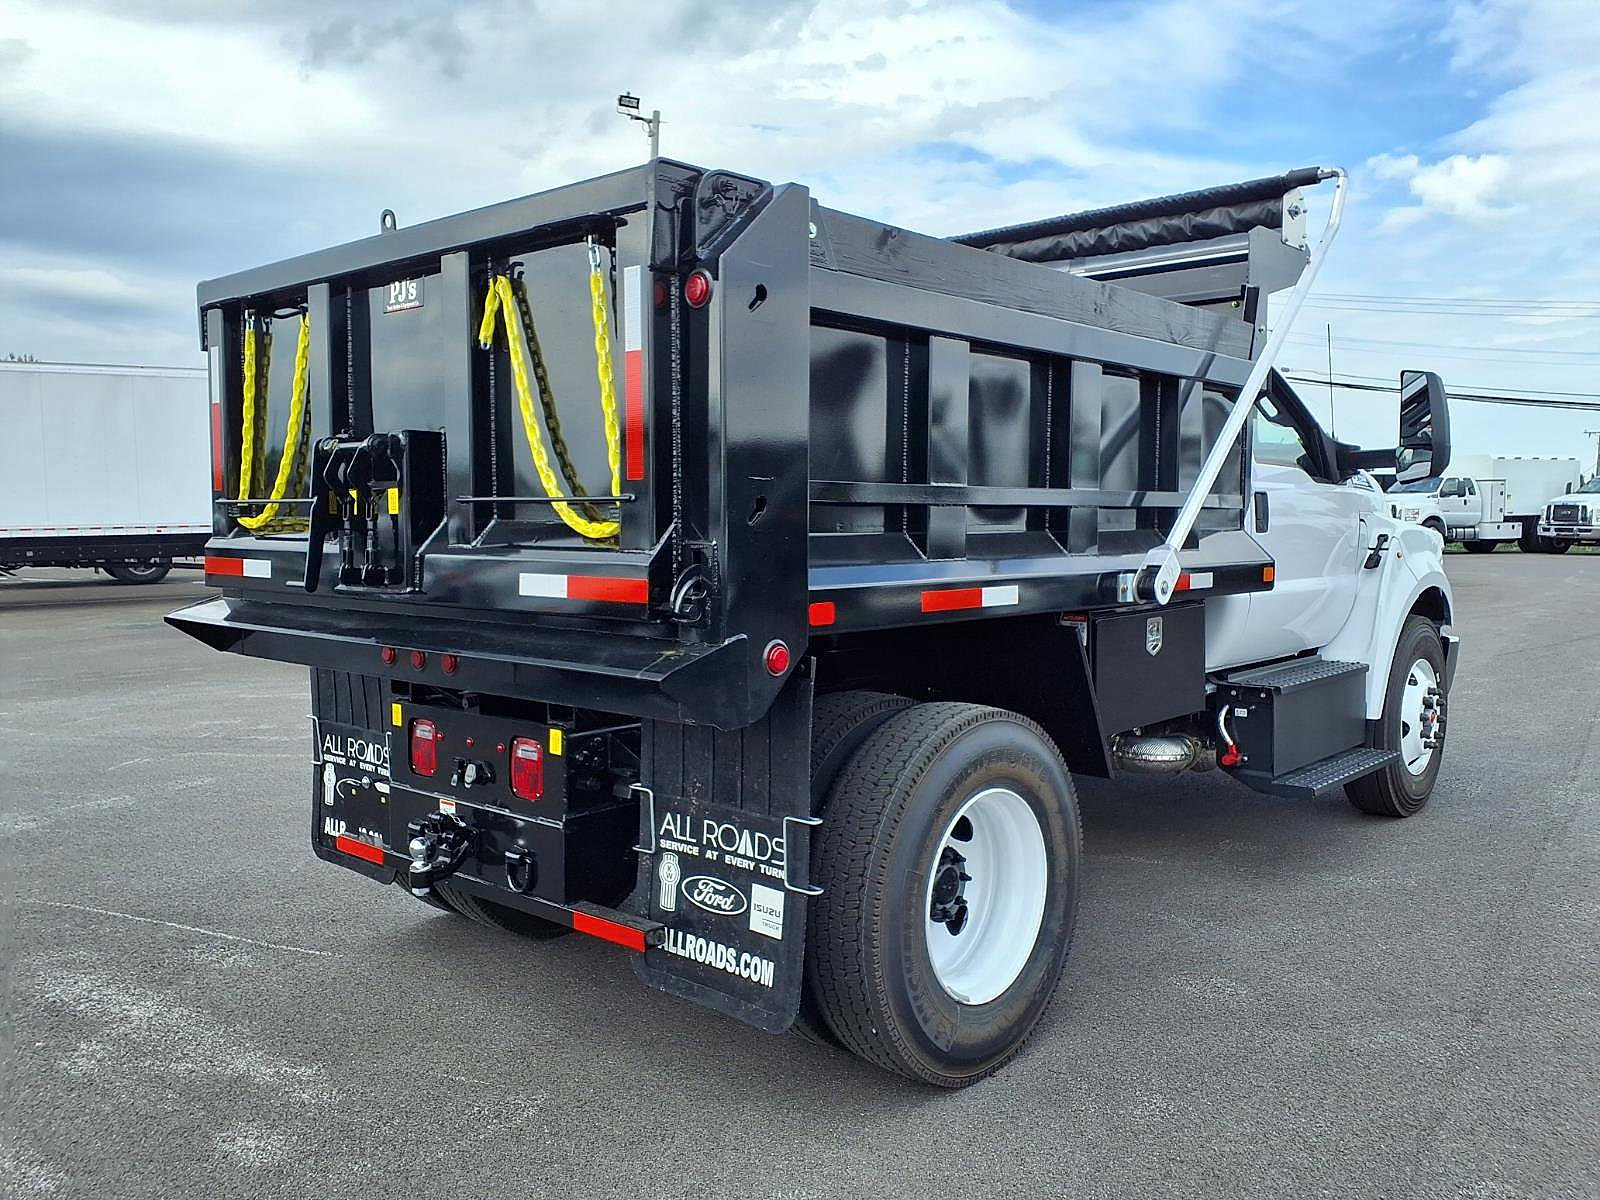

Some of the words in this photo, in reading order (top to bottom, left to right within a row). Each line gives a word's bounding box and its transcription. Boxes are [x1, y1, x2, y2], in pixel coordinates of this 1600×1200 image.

[389, 280, 417, 304] PJ's
[323, 733, 345, 756] ALL
[347, 737, 390, 768] ROADS
[349, 759, 357, 768] AT
[659, 811, 697, 843] ALL
[702, 819, 785, 866] ROADS
[659, 838, 700, 856] SERVICE
[705, 849, 719, 861] AT
[724, 854, 756, 871] EVERY
[759, 863, 785, 880] TURN
[693, 879, 737, 911] Ford
[753, 903, 781, 918] ISUZU
